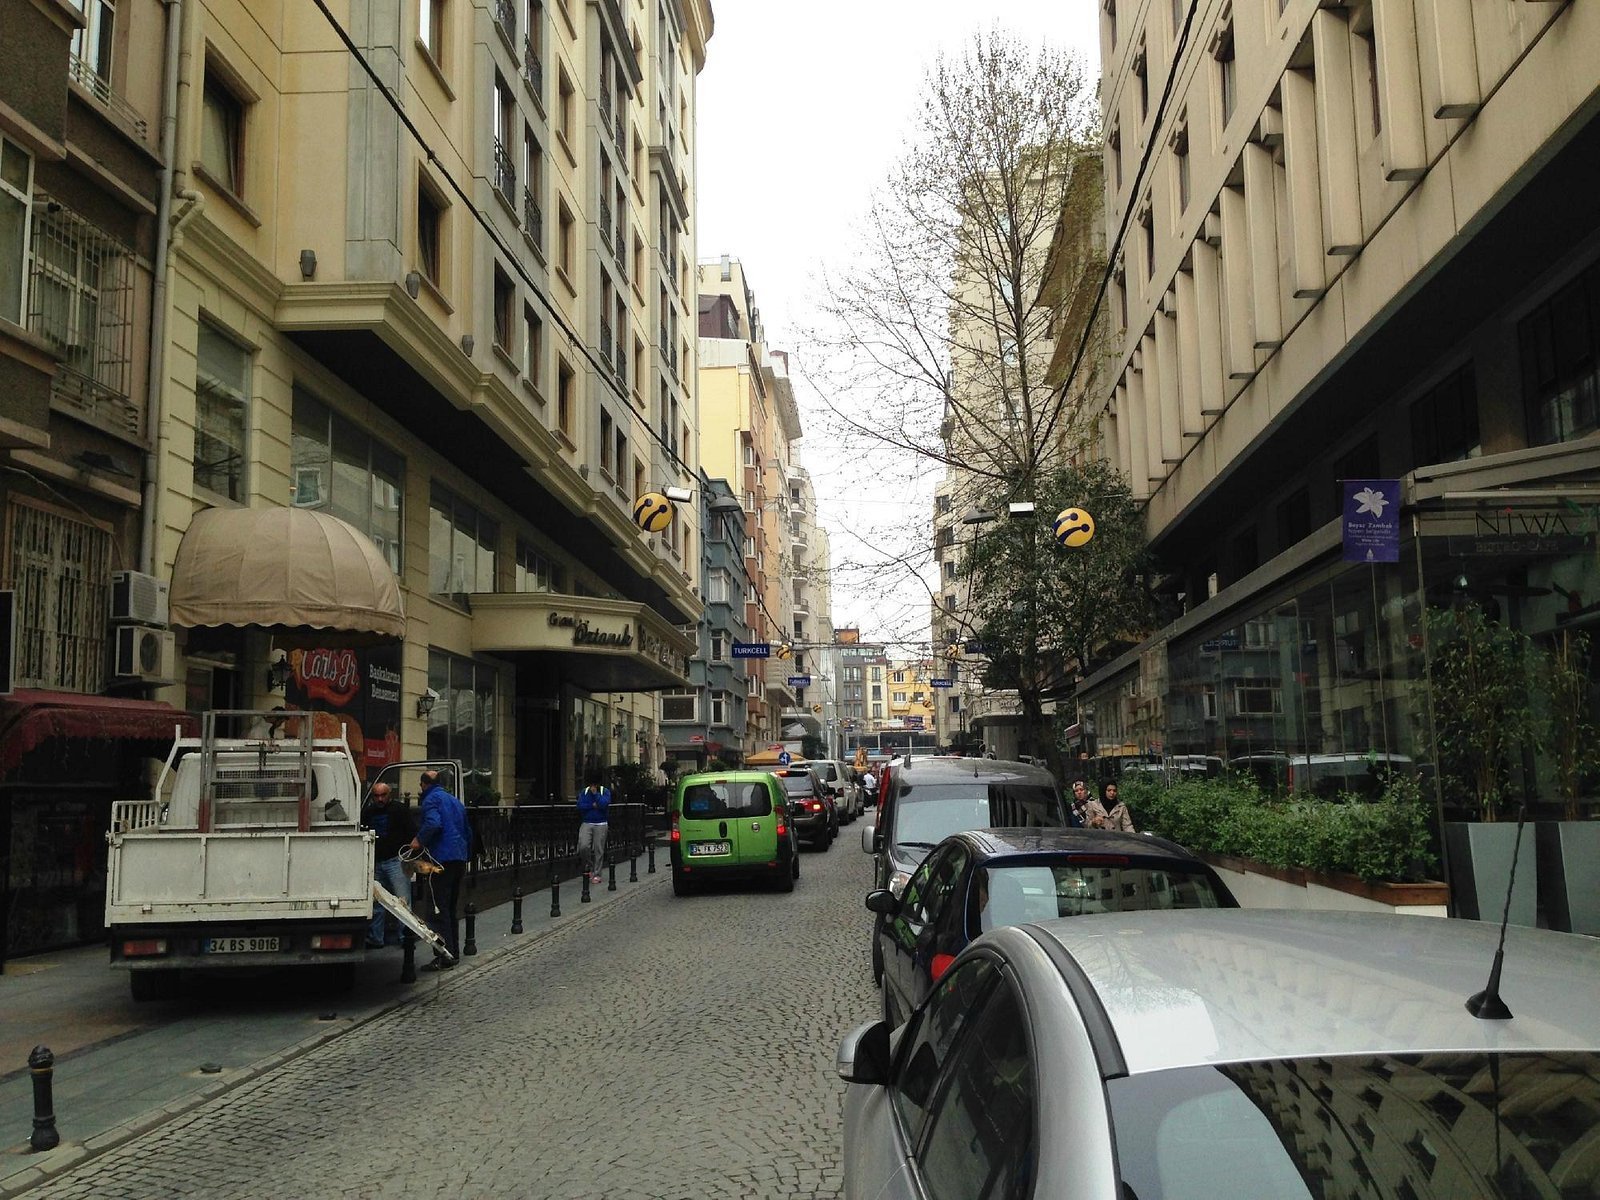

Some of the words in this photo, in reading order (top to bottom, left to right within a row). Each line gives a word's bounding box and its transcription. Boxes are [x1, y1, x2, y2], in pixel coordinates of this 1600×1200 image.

[734, 647, 768, 655] TURKCELL
[210, 939, 225, 952] 34
[229, 939, 245, 951] BS
[249, 938, 277, 951] 9016
